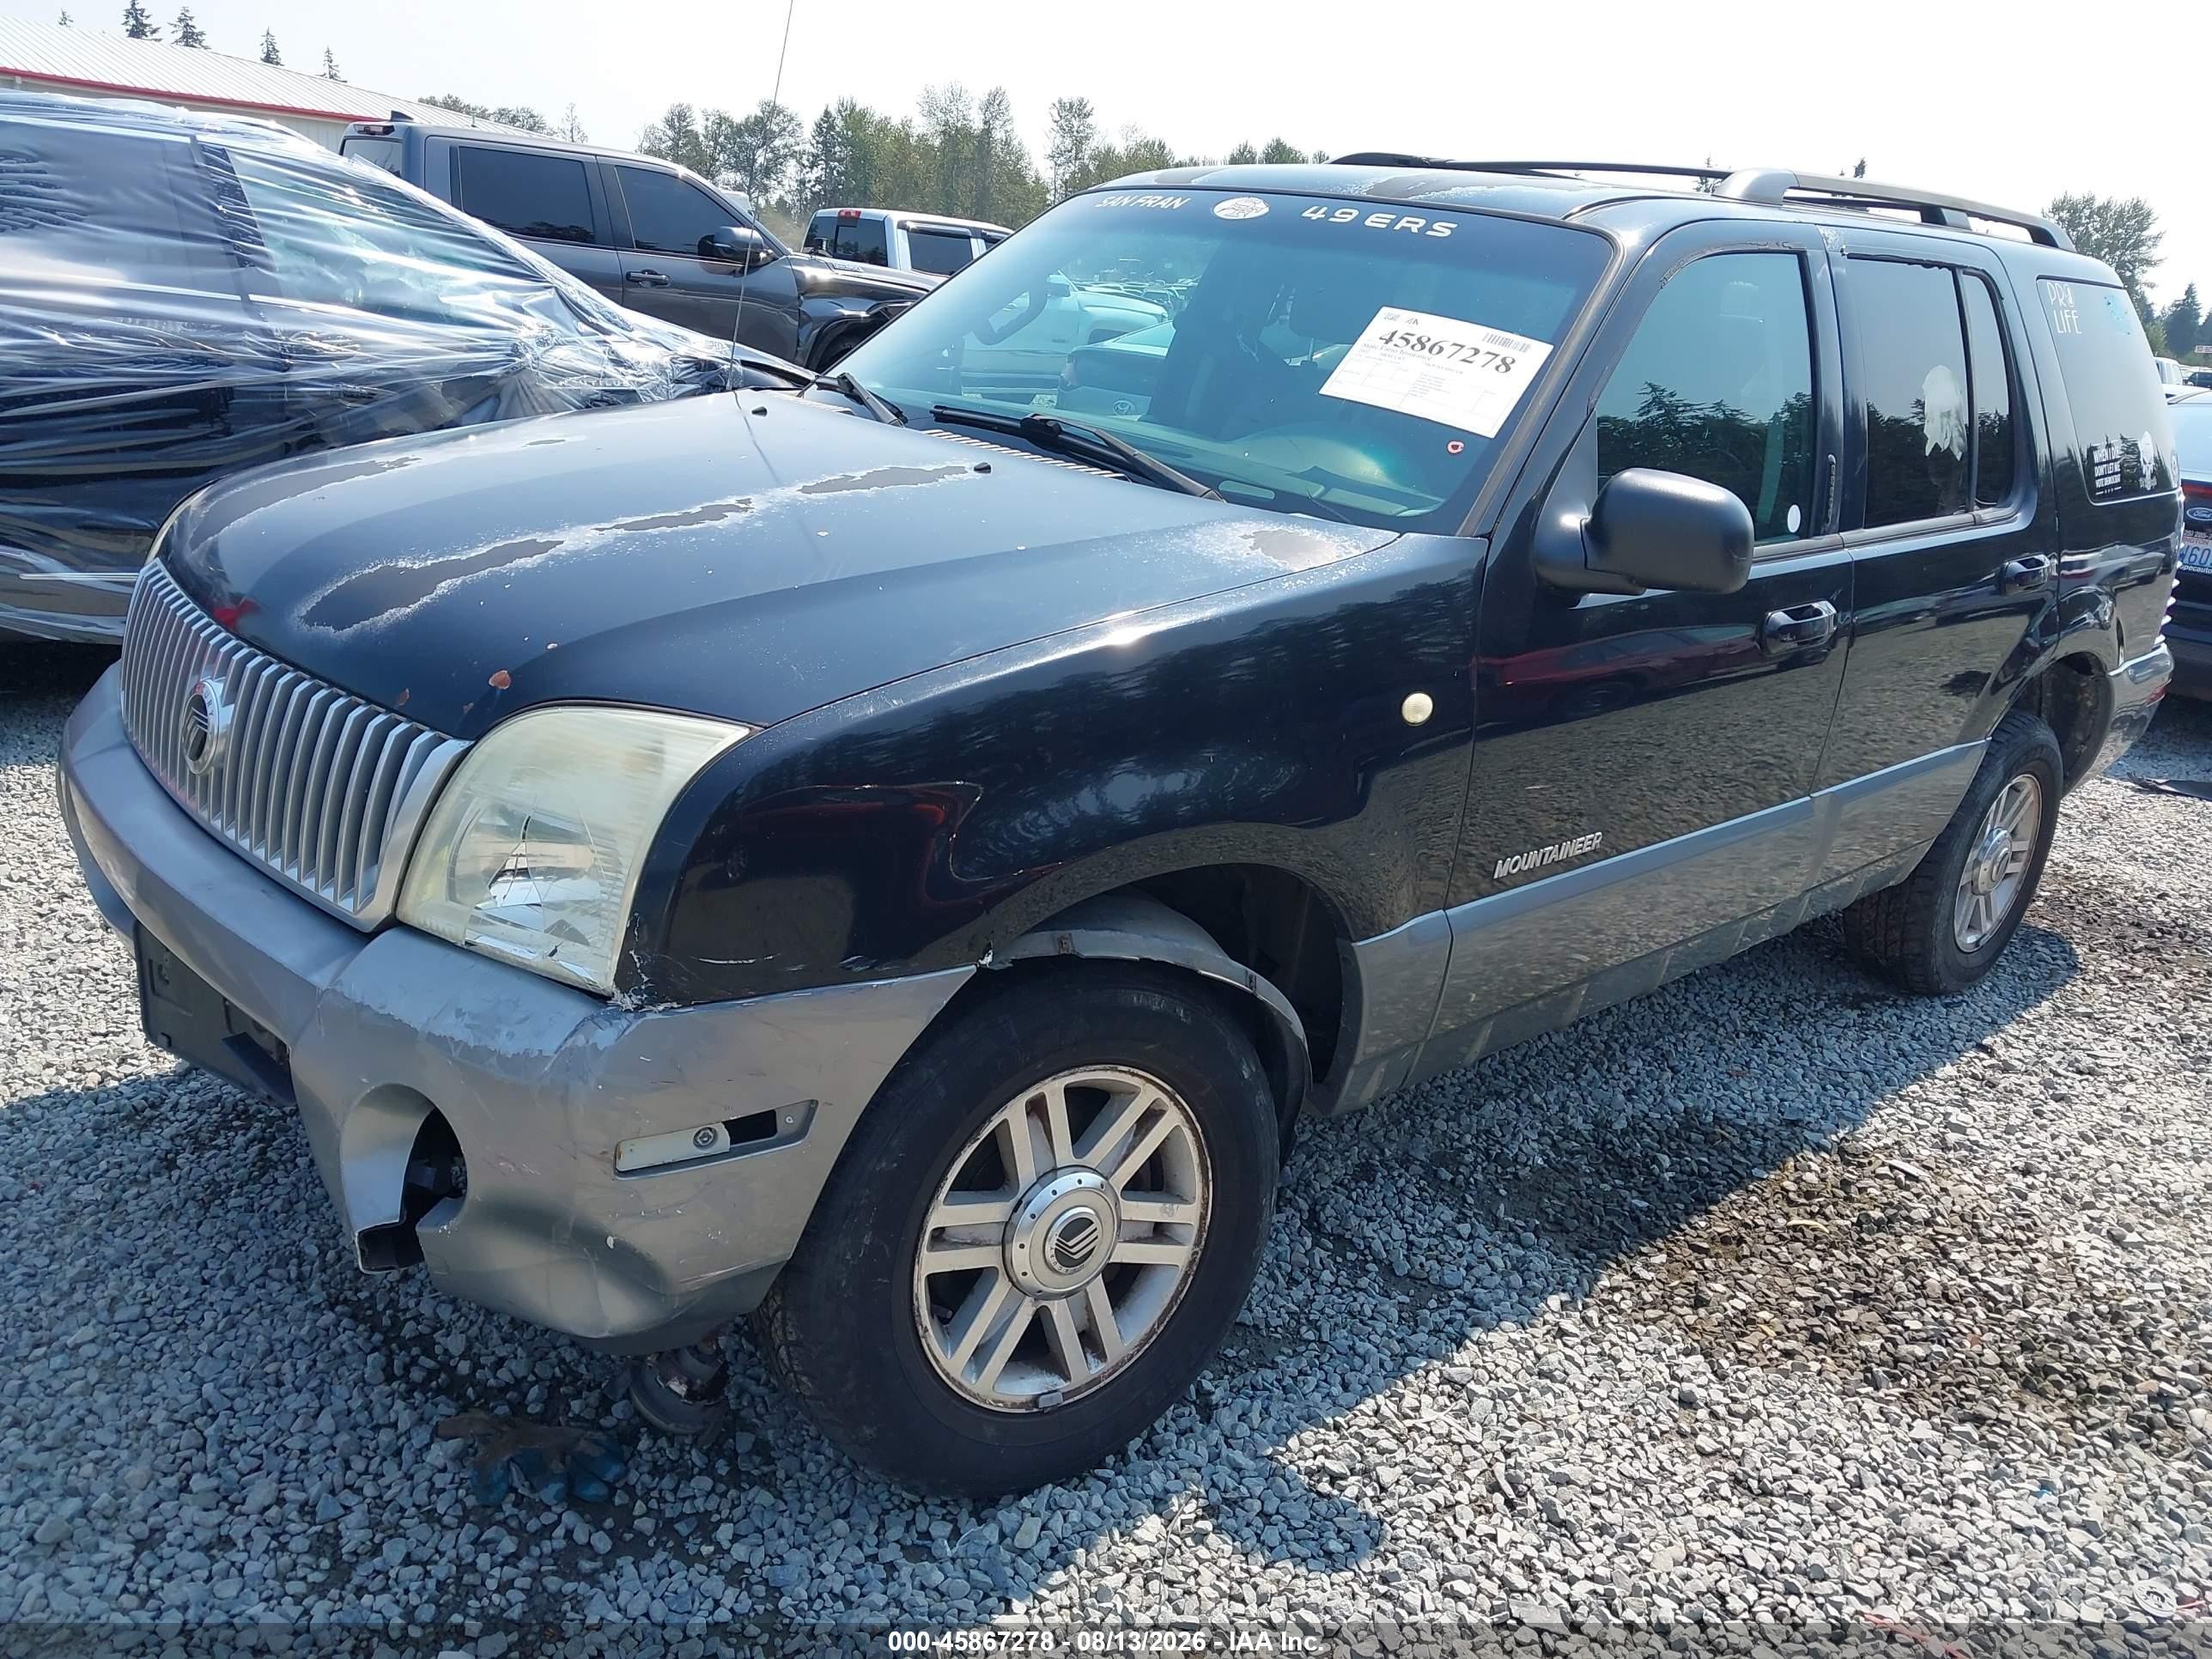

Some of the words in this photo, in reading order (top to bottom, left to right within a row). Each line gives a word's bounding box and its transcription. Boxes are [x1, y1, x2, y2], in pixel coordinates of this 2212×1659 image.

[1095, 195, 1139, 207] SAN
[1138, 196, 1191, 210] FRAN
[2053, 309, 2081, 334] LIFE
[1379, 329, 1516, 374] 45867278
[1493, 831, 1603, 879] MOUNTAINEER
